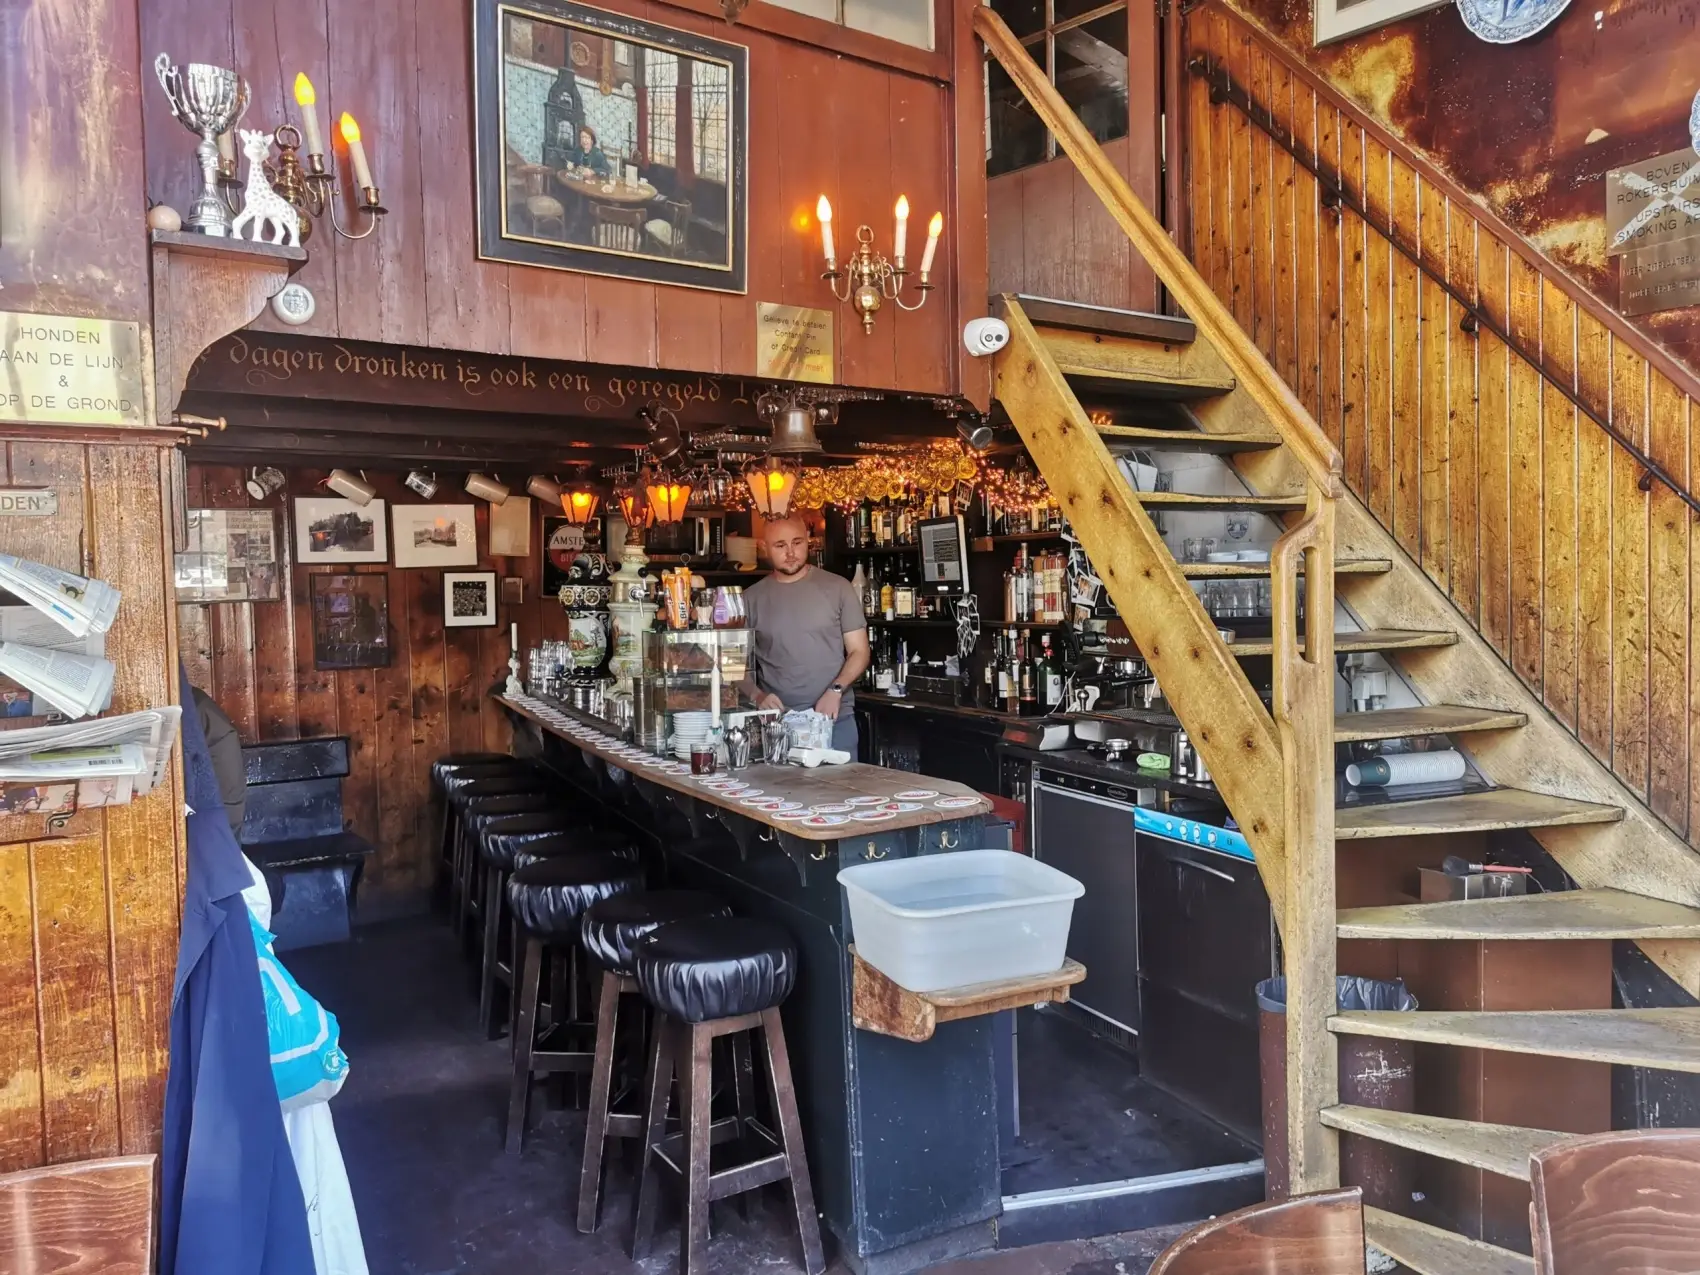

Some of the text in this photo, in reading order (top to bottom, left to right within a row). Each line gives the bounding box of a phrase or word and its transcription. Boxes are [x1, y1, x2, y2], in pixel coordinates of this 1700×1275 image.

[1646, 160, 1691, 182] BOVEN
[1617, 219, 1677, 243] SMOKING
[21, 327, 101, 344] HONDEN
[0, 349, 124, 369] AAN DE LIJN
[58, 375, 69, 387] &
[229, 335, 325, 386] dagen
[333, 344, 448, 381] dronken
[456, 358, 482, 394] is
[490, 361, 537, 389] ook
[548, 372, 590, 393] een
[607, 374, 721, 411] geregeld
[31, 395, 56, 409] DE
[67, 397, 132, 412] GROND
[1, 496, 40, 510] DEN
[553, 536, 584, 546] AMSTE
